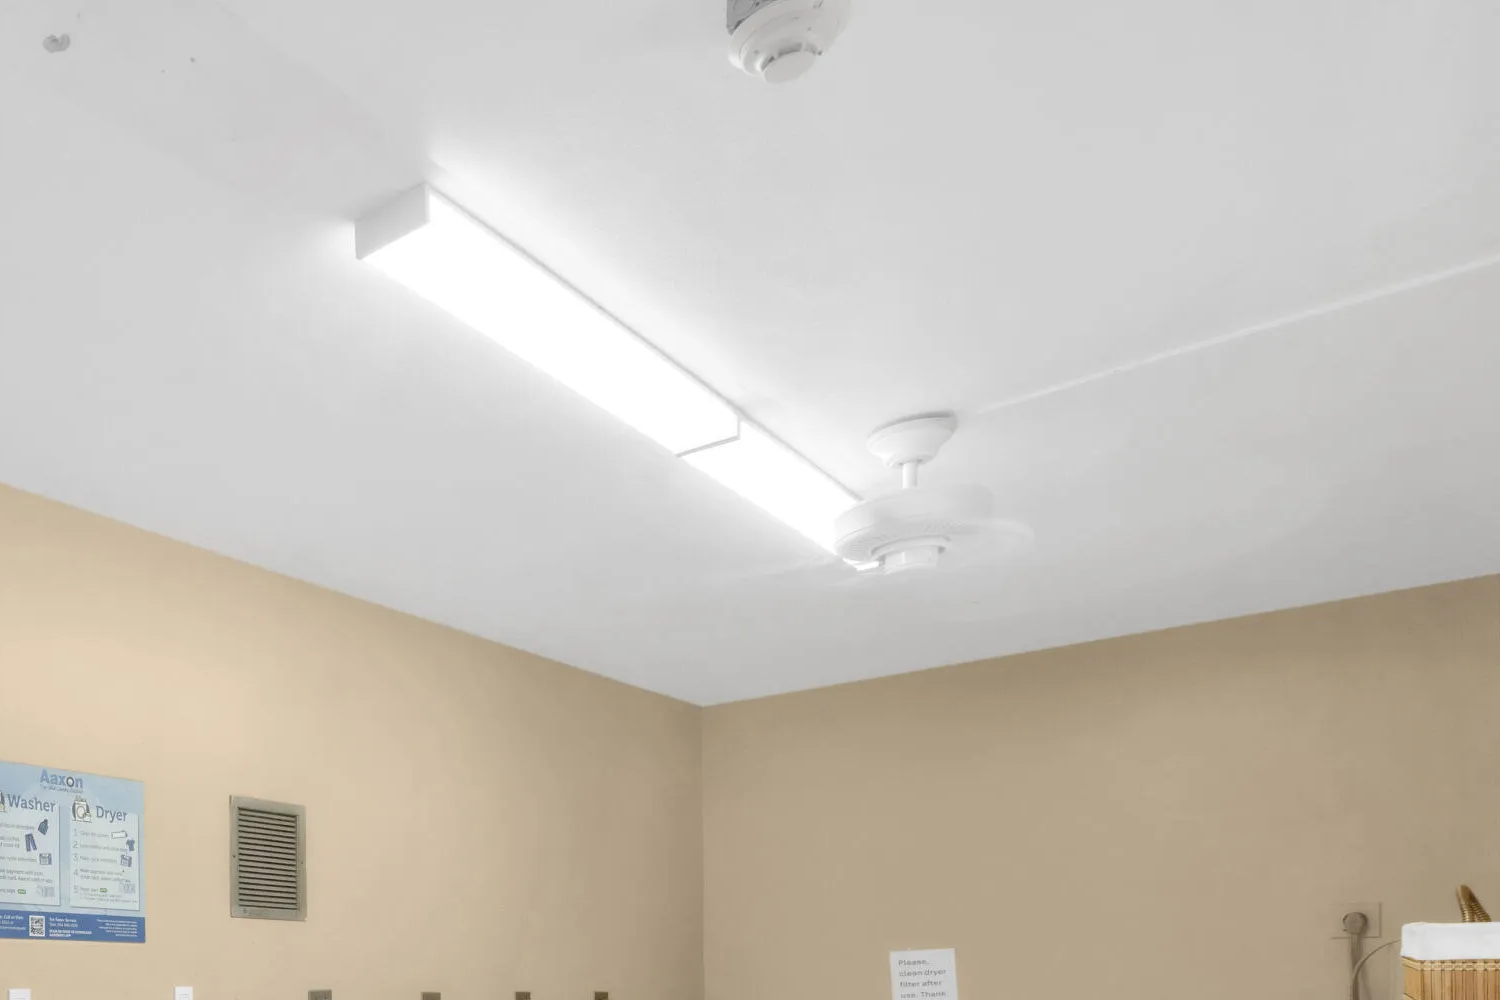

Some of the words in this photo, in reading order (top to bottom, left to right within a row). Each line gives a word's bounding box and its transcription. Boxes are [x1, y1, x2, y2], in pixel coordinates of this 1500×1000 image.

[40, 769, 83, 789] Aaxon
[8, 794, 56, 812] Washer
[96, 805, 128, 823] Dryer
